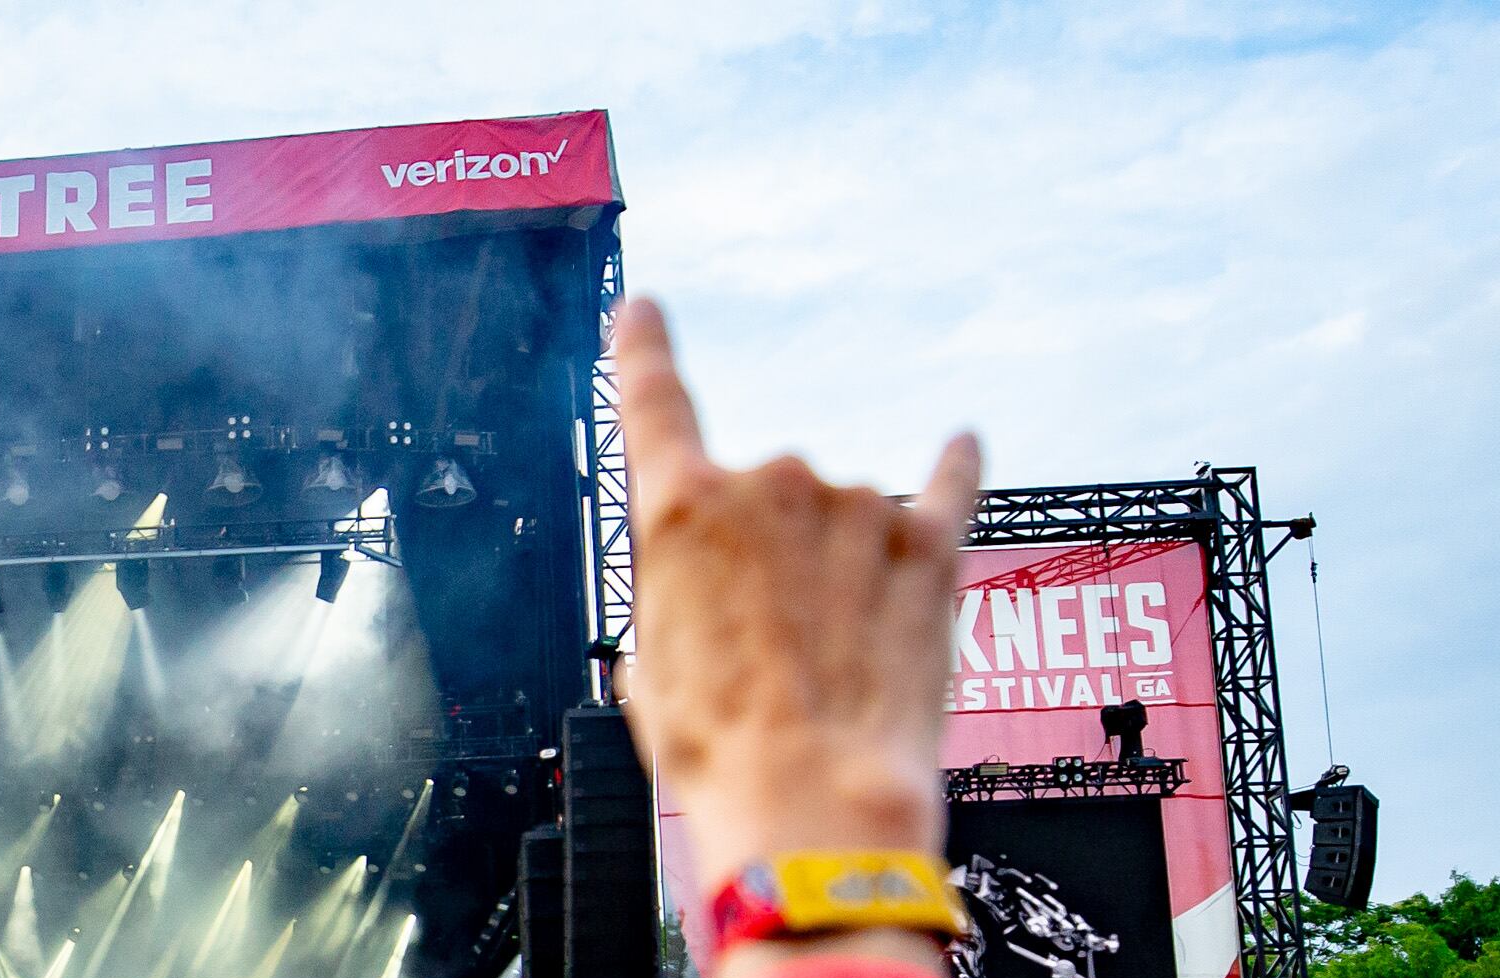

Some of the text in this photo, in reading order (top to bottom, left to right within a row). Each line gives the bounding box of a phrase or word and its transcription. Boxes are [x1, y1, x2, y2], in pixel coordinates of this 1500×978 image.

[381, 150, 550, 188] verizon
[948, 581, 1173, 673] KNEES
[1136, 679, 1171, 698] GA
